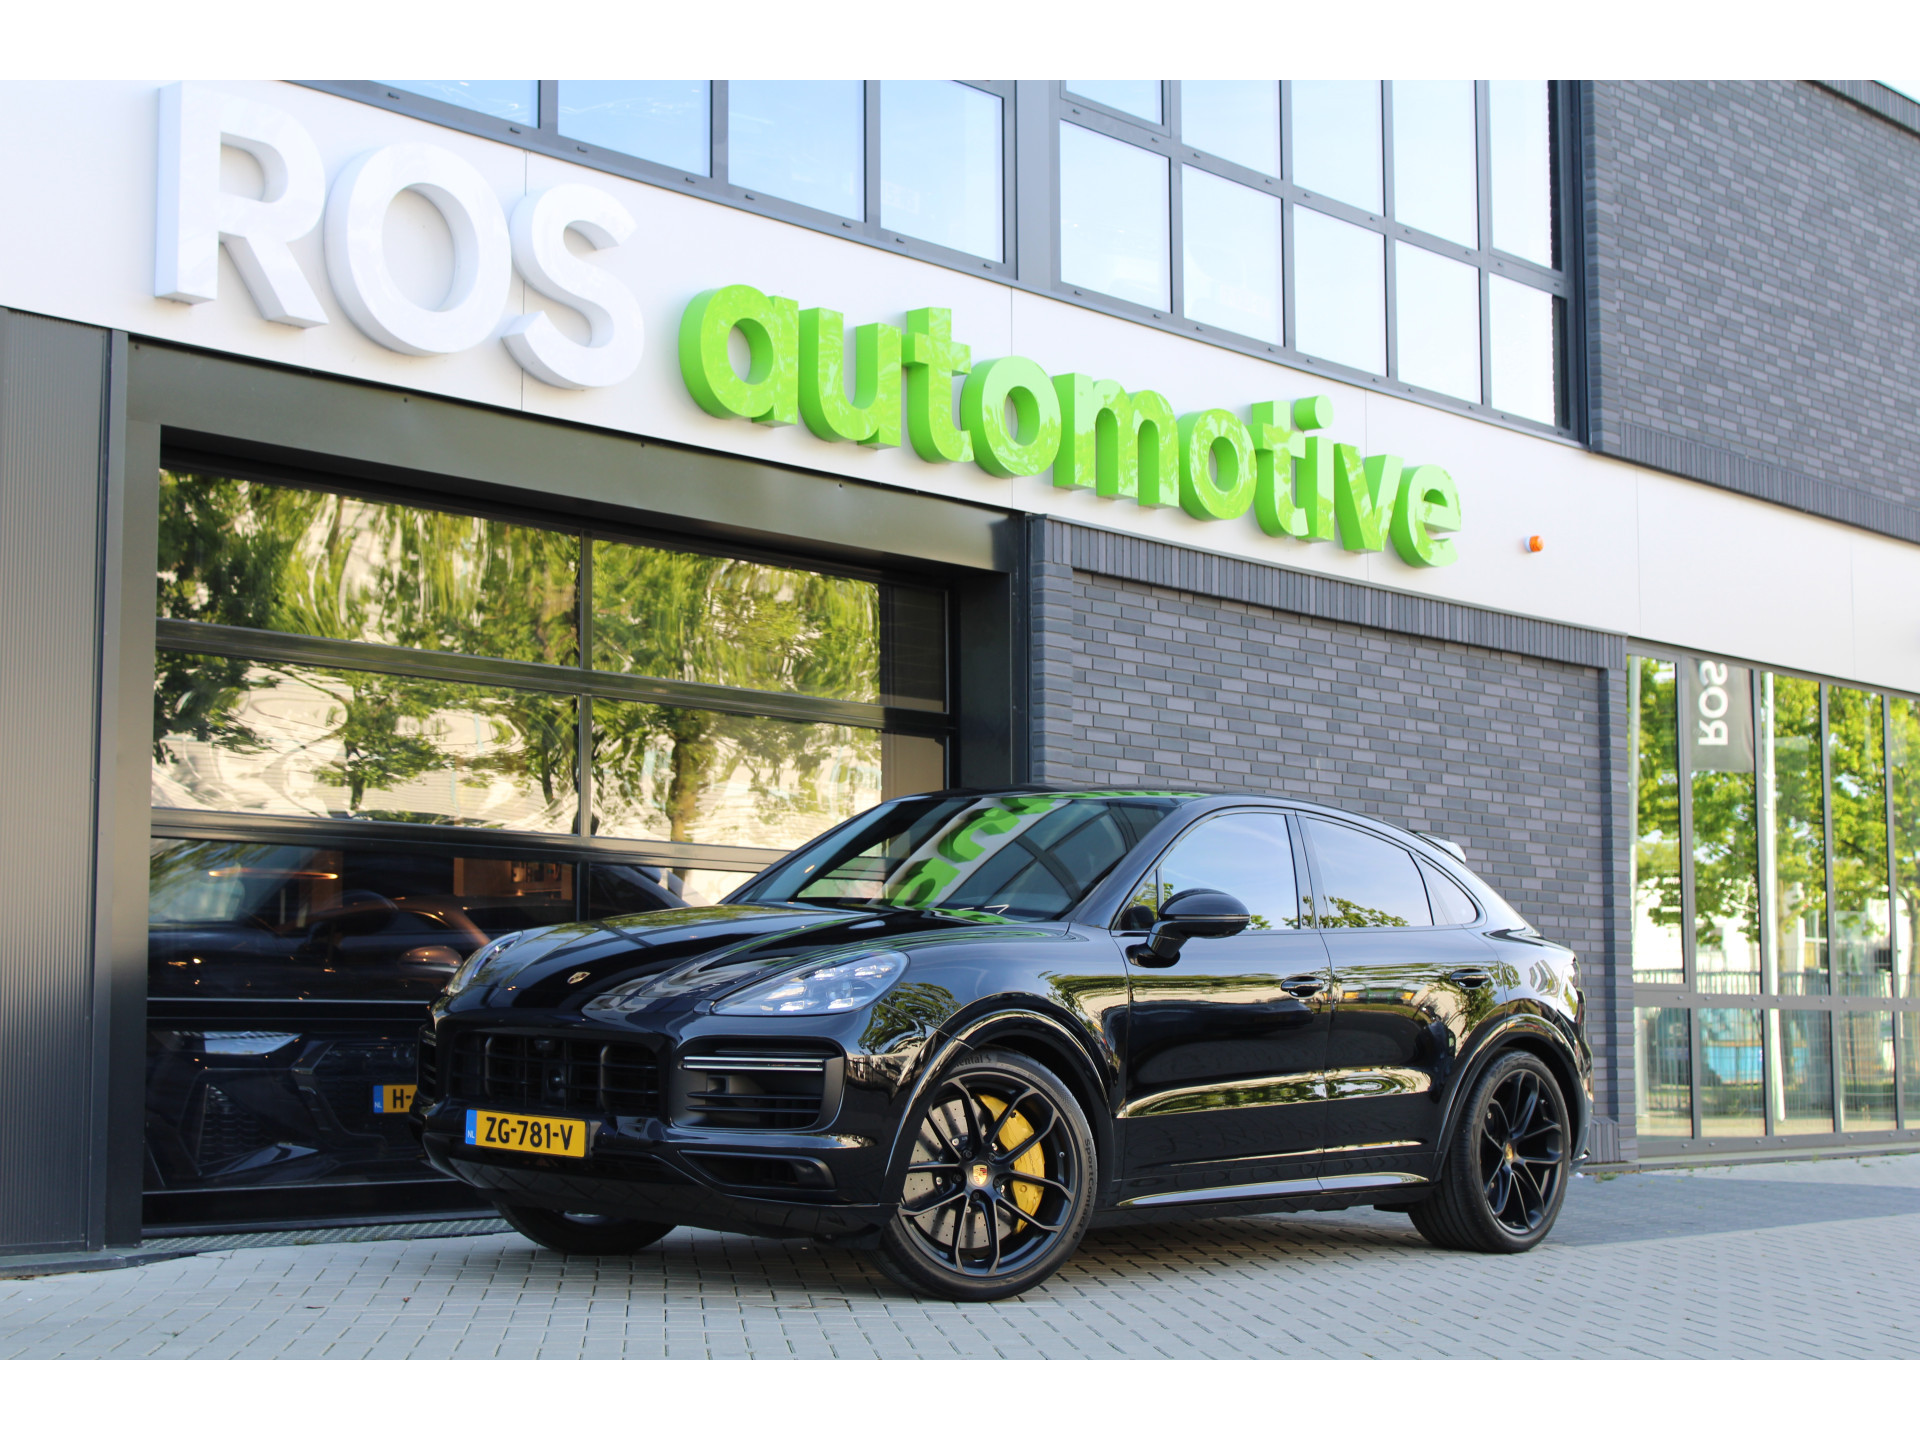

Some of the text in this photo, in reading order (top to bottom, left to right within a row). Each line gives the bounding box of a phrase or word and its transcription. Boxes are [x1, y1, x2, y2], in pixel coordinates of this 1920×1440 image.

[155, 81, 644, 388] ROS
[680, 285, 1463, 568] automotive
[467, 1130, 475, 1139] NL
[485, 1116, 573, 1150] ZG-781-V
